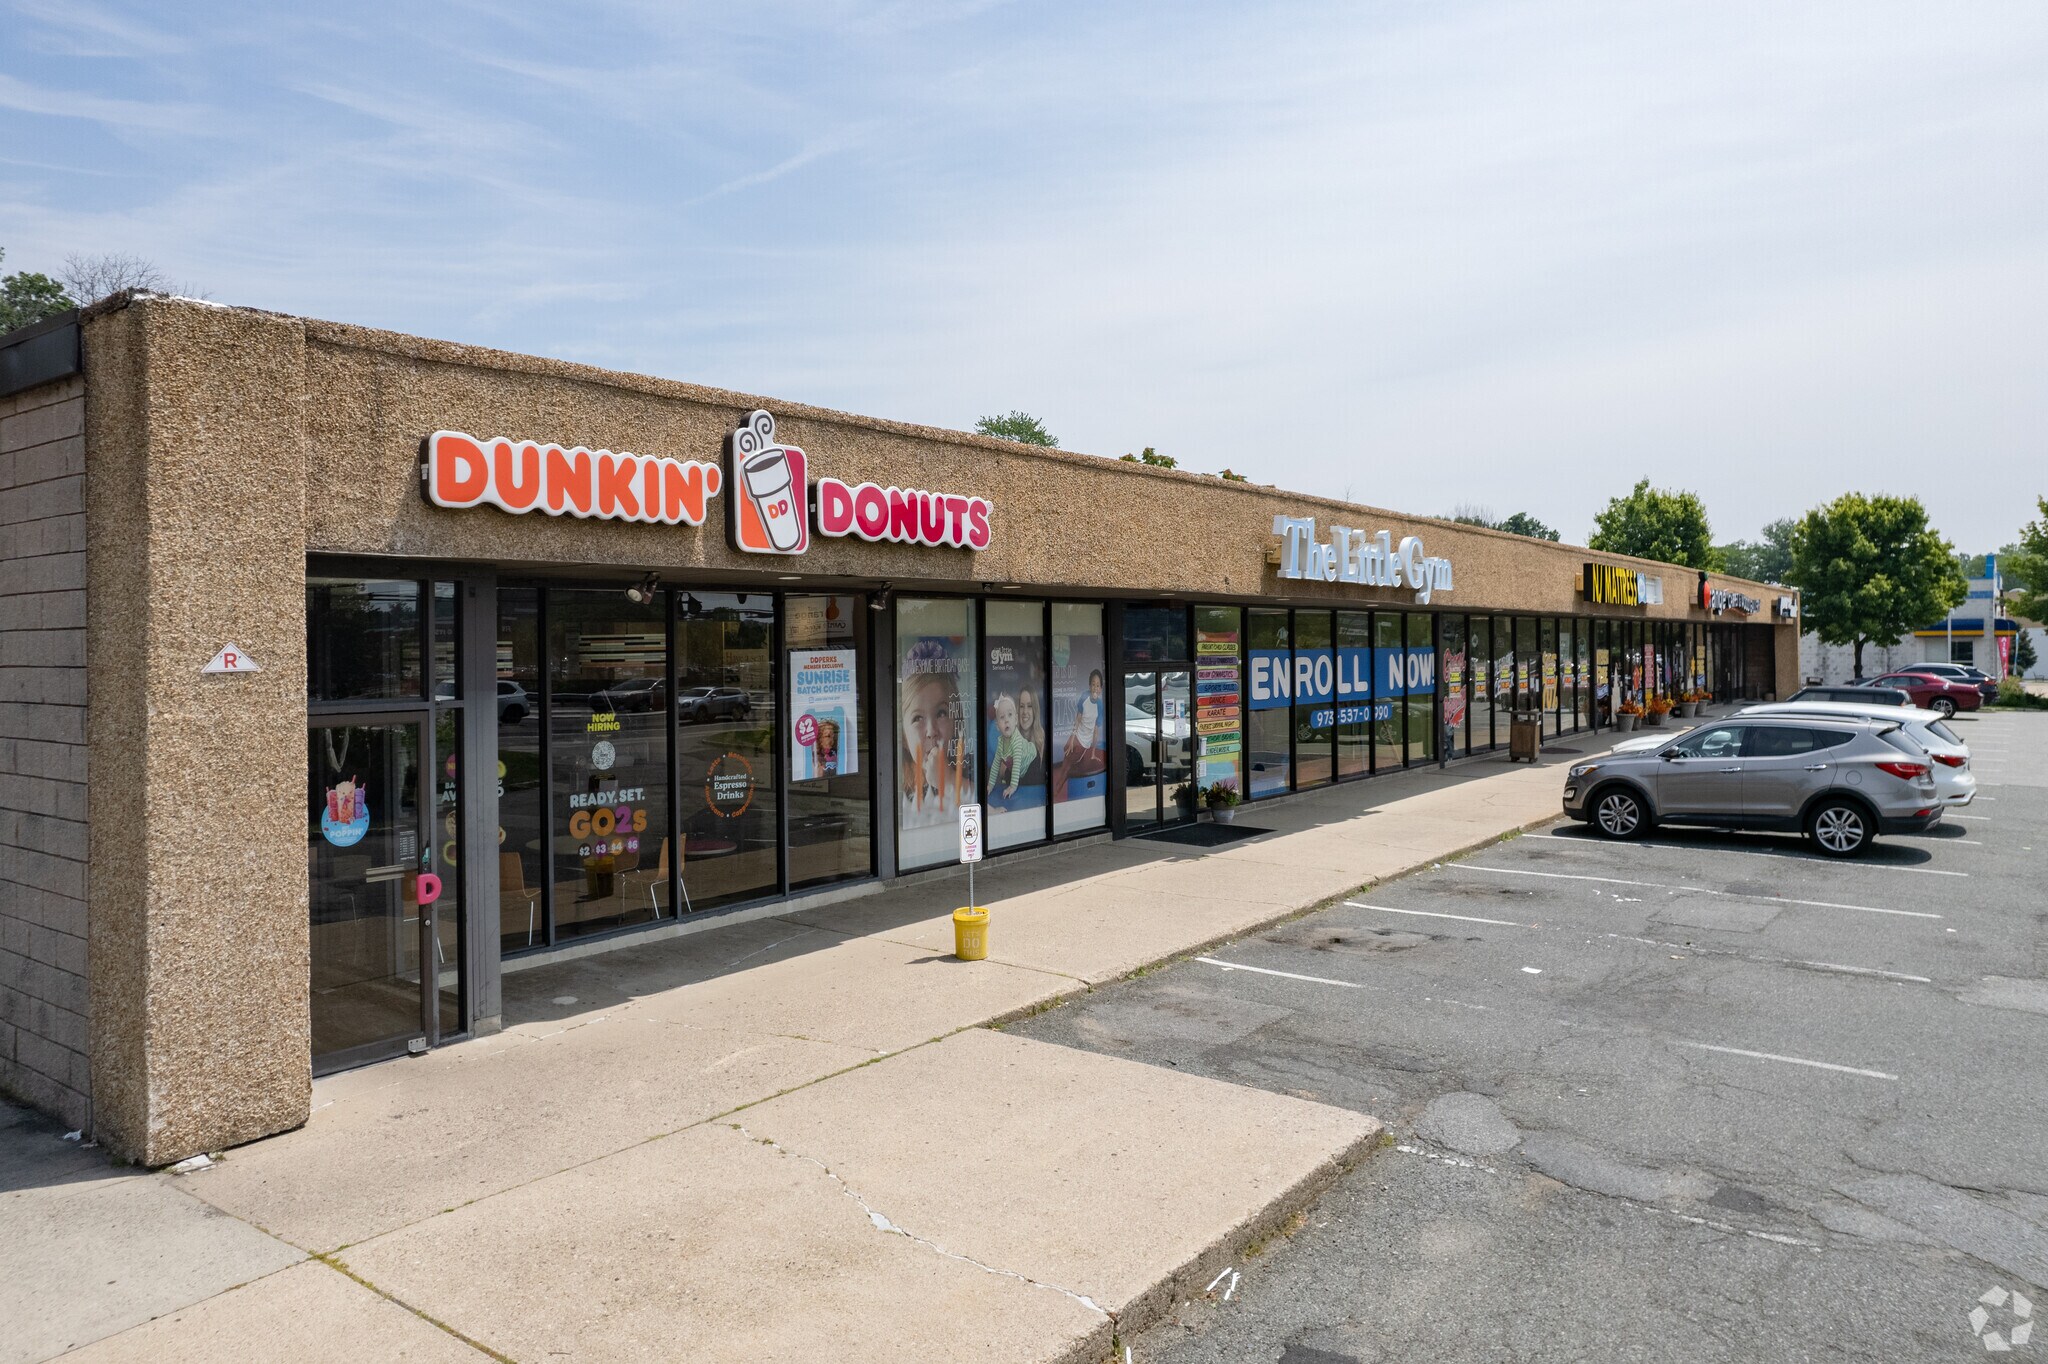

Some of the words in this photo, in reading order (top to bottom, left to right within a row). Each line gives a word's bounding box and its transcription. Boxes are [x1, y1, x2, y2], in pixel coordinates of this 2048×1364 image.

[436, 436, 720, 523] DUNKIN'
[767, 499, 789, 520] DD
[822, 481, 990, 548] DONUTS
[1272, 515, 1338, 582] The
[1330, 525, 1402, 588] Little
[1400, 536, 1454, 605] Gym
[1592, 563, 1603, 604] NJ
[1604, 565, 1638, 606] MATTRESS
[223, 652, 238, 669] R
[991, 649, 1014, 665] gym
[934, 658, 957, 673] BIRTHDAY
[797, 670, 850, 685] SUNRISE
[1251, 654, 1369, 700] ENROLL
[1388, 653, 1435, 690] NOW!
[797, 686, 822, 695] BATCH
[823, 684, 850, 693] COFFEE
[1209, 696, 1226, 704] DANCE
[592, 712, 616, 723] NOW
[948, 701, 972, 719] PARTIES
[1207, 708, 1227, 717] KARATE
[587, 722, 621, 732] HIRING
[799, 718, 815, 735] $2
[954, 719, 967, 737] FOR
[714, 774, 747, 782] Handcrafted
[714, 781, 747, 791] Espresso
[570, 790, 618, 808] READY.
[619, 787, 646, 802] SET.
[717, 791, 744, 800] Drinks
[329, 827, 364, 839] POPPIN'
[579, 846, 590, 857] $2
[595, 844, 607, 854] $3
[611, 841, 623, 852] $4
[627, 839, 638, 850] $6
[963, 938, 980, 949] DO
